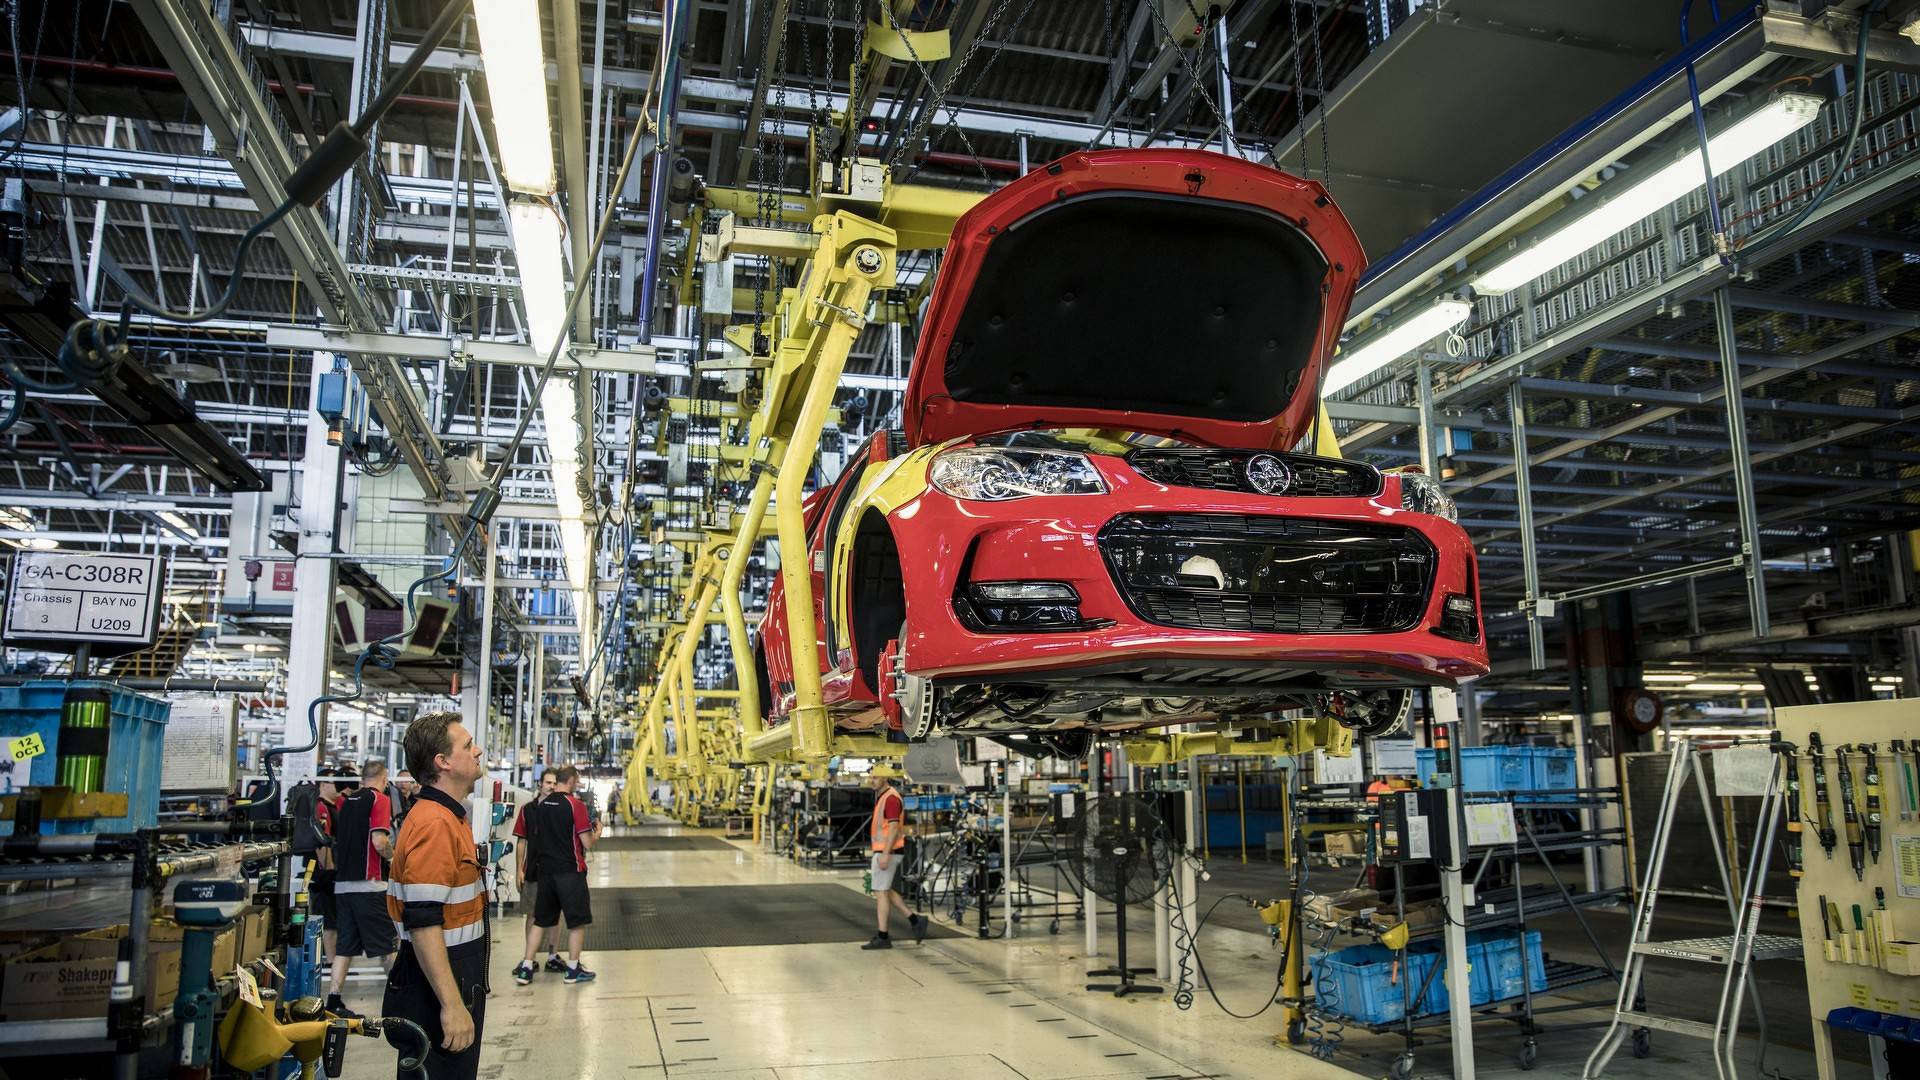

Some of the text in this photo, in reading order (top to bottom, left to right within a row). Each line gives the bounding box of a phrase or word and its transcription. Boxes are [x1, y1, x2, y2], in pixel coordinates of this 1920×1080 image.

[26, 564, 143, 584] GA-C308R
[24, 592, 72, 604] Chassis
[92, 596, 117, 606] BAY
[41, 614, 49, 624] 3
[91, 618, 131, 631] U209
[18, 737, 33, 748] 12
[15, 744, 40, 759] OCT
